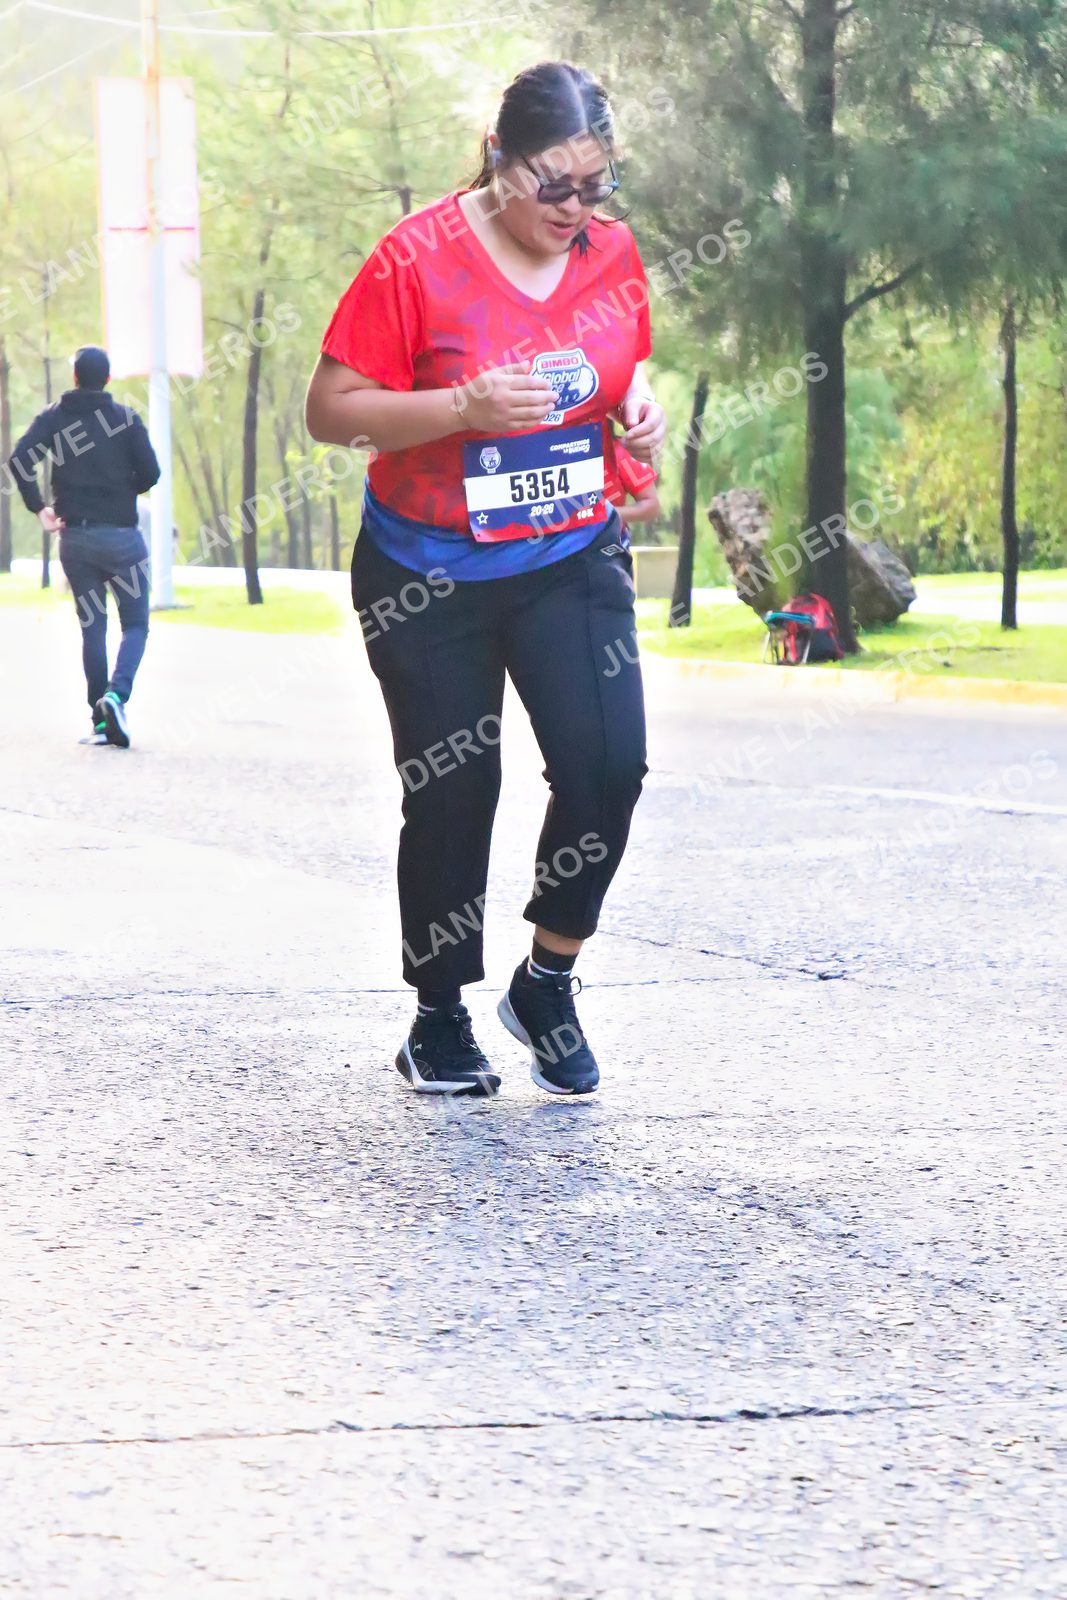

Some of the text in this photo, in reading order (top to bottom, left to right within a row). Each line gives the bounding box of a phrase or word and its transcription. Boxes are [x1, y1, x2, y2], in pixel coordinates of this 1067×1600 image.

[541, 357, 579, 369] BIMBO
[510, 468, 570, 503] 5354
[576, 508, 594, 520] 10K
